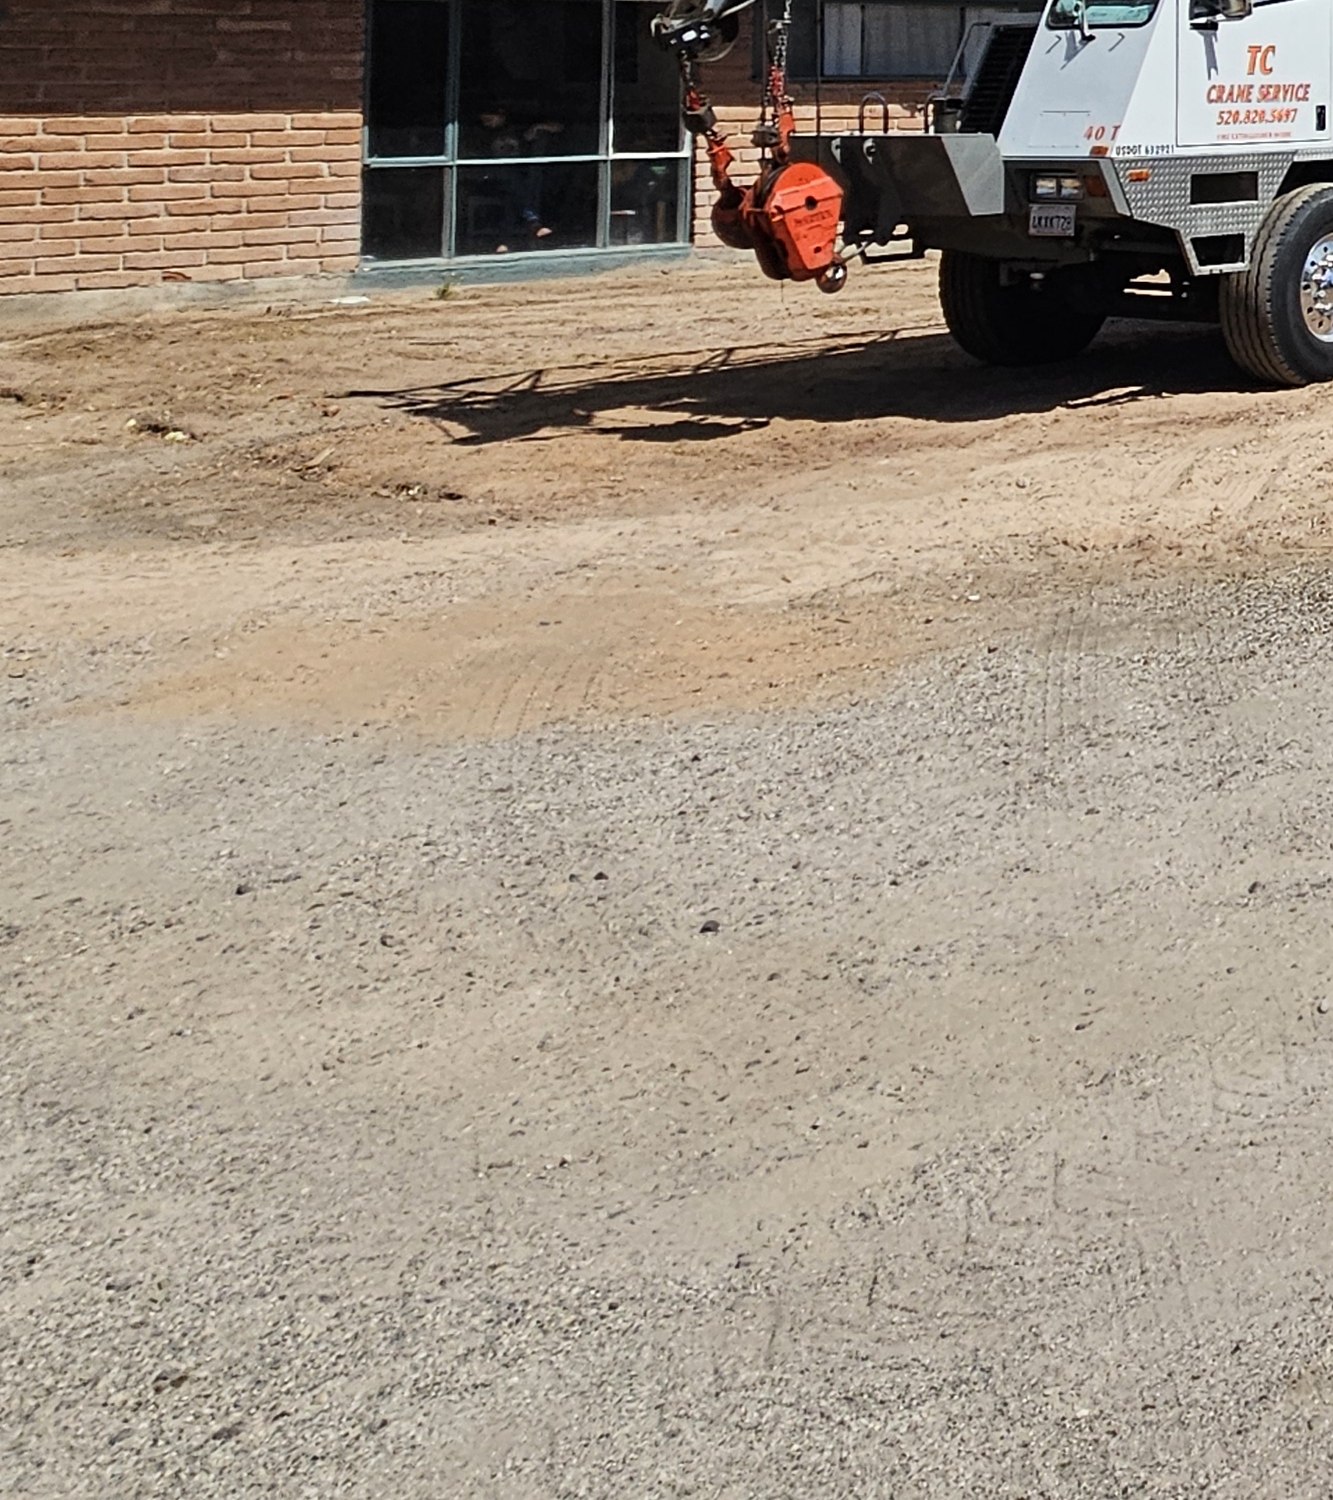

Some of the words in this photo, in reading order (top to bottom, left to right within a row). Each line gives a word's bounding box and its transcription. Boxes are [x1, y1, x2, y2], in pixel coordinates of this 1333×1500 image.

[1246, 45, 1276, 76] TC
[1206, 84, 1255, 104] CRANE
[1256, 83, 1311, 103] SERVICE
